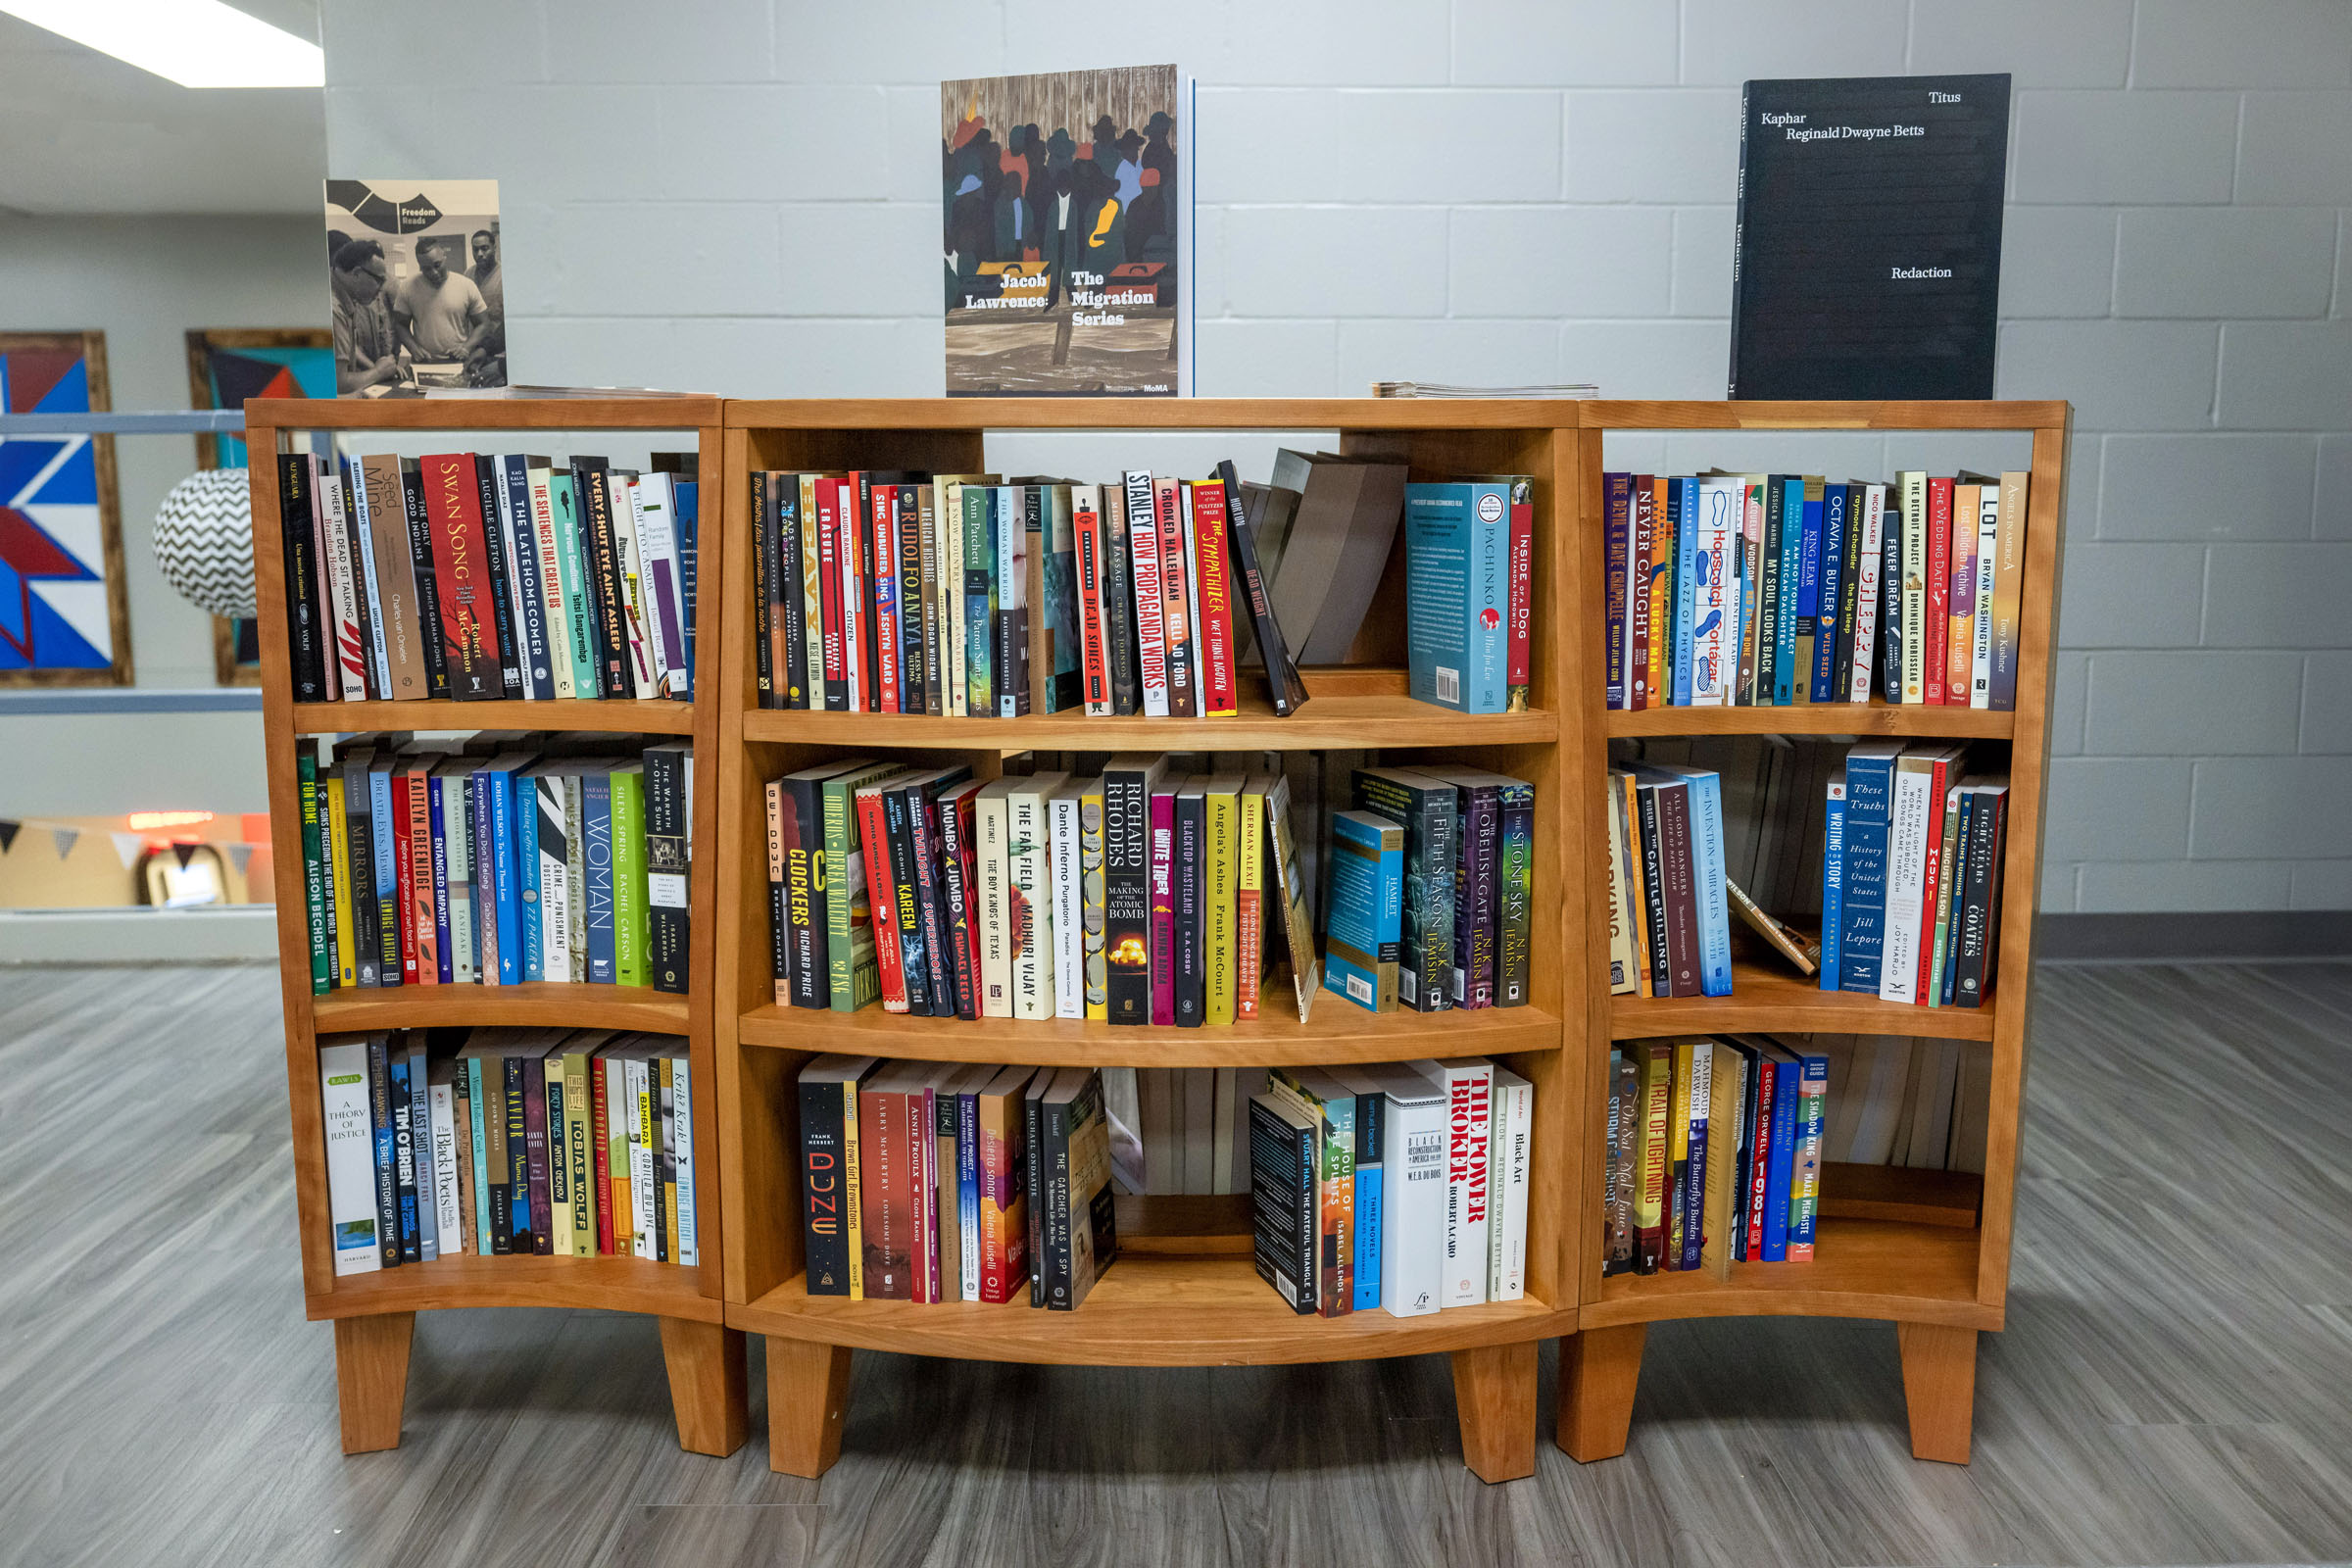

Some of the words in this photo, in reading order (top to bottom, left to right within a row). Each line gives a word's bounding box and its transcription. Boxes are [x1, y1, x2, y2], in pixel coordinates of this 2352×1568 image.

[1929, 92, 1961, 103] Titus
[1762, 113, 1806, 124] Kaphar
[1787, 127, 1838, 141] Reginald
[1842, 126, 1890, 139] Dwayne
[1893, 125, 1924, 137] Betts
[402, 208, 436, 217] Freedom
[1001, 272, 1047, 289] Jacob
[1072, 271, 1103, 286] The
[1891, 268, 1951, 279] Redaction
[965, 295, 1048, 310] Lawrence:
[1072, 291, 1154, 307] Migration
[1072, 312, 1124, 326] Series
[1145, 384, 1168, 393] MoMA
[330, 484, 342, 515] WHERE
[440, 463, 461, 518] SWAN
[482, 479, 496, 523] LUCILLE
[534, 484, 547, 499] THE
[970, 496, 979, 518] Ann
[1128, 474, 1153, 528] STANLEY
[334, 519, 344, 536] THE
[514, 500, 525, 526] THE
[536, 501, 553, 544] SENTENCES
[1161, 488, 1175, 534] CROOKED
[1639, 490, 1650, 551] NEVER
[1829, 496, 1842, 550] OCTAVIA
[1982, 501, 1997, 539] LOT
[337, 538, 347, 563] DEAD
[447, 523, 469, 580] SONG
[487, 526, 501, 571] CLIFTON
[820, 508, 832, 563] ERASURE
[901, 512, 919, 587] RUDOLFO
[971, 522, 981, 564] Patchett
[1133, 532, 1154, 560] HOW
[339, 565, 348, 578] SIT
[543, 546, 554, 564] THAT
[1165, 539, 1179, 601] HALLELUJAH
[1485, 528, 1494, 605] PACHINKO
[1710, 530, 1725, 608] Hopscotch
[1767, 559, 1777, 573] MY
[1828, 556, 1837, 564] E.
[545, 567, 559, 595] CREATE
[1765, 575, 1776, 605] SOUL
[1824, 569, 1836, 611] BUTLER
[1983, 559, 1991, 590] BRYAN
[342, 581, 354, 618] TALKING
[518, 533, 542, 656] LATEHOMECOMER
[549, 597, 561, 609] US
[1136, 564, 1160, 645] PROPAGANDA
[1636, 560, 1648, 638] CAUGHT
[905, 592, 921, 646] ANAYA
[1170, 612, 1182, 640] KELLI
[1682, 611, 1690, 625] OF
[1764, 609, 1773, 643] LOOKS
[1979, 595, 1989, 660] WASHINGTON
[458, 611, 472, 672] McCammon
[471, 623, 482, 659] Robert
[1172, 644, 1184, 658] JO
[1680, 632, 1689, 681] PHYSICS
[1709, 619, 1722, 682] Cortázar
[1762, 646, 1772, 673] BACK
[1144, 647, 1165, 689] WORKS
[1173, 662, 1186, 687] FORD
[302, 781, 315, 800] FUN
[411, 777, 427, 823] KAITLYN
[617, 786, 626, 820] SILENT
[1850, 800, 1886, 809] Truths
[1853, 785, 1883, 795] These
[305, 802, 317, 824] HOME
[824, 795, 843, 839] OMEROS
[942, 805, 957, 852] MUMBO
[1019, 804, 1031, 825] THE
[1059, 805, 1069, 837] Dante
[1108, 782, 1124, 867] RHODES
[1127, 782, 1143, 867] RICHARD
[1215, 804, 1226, 855] Angela's
[1829, 812, 1841, 851] WRITING
[617, 825, 627, 862] SPRING
[1020, 831, 1030, 852] FAR
[1510, 832, 1524, 887] STONE
[352, 824, 368, 899] MIRRORS
[414, 830, 429, 891] GREENIDGE
[587, 814, 612, 928] WOMAN
[826, 850, 846, 884] DEREK
[1020, 858, 1032, 891] FIELD
[1059, 842, 1070, 881] Inferno
[1216, 859, 1225, 895] Ashes
[1829, 860, 1841, 889] STORY
[1929, 848, 1938, 885] MAUS
[309, 859, 320, 902] ALISON
[619, 874, 628, 912] RACHEL
[789, 849, 809, 925] CLOCKERS
[948, 867, 962, 912] JUMBO
[1389, 877, 1397, 916] HAMLET
[829, 889, 848, 938] WALCOTT
[1060, 885, 1070, 926] Purgatorio
[1216, 906, 1225, 941] Frank
[1509, 892, 1522, 922] SKY
[312, 906, 324, 956] BECHDEL
[621, 918, 630, 960] CARSON
[799, 929, 809, 967] RICHARD
[1022, 906, 1034, 958] MADHURI
[1965, 906, 1979, 956] COATES
[802, 971, 812, 998] PRICE
[1023, 963, 1035, 996] VIJAY
[1216, 946, 1225, 996] McCourt
[414, 1090, 425, 1106] THE
[1470, 1073, 1489, 1132] THE
[1649, 1082, 1667, 1118] TRAIL
[1763, 1071, 1772, 1111] GEORGE
[416, 1108, 426, 1131] LAST
[1332, 1122, 1341, 1149] THE
[1343, 1111, 1351, 1135] THE
[1449, 1079, 1469, 1183] BROKER
[1649, 1120, 1666, 1136] OF
[1760, 1115, 1769, 1154] ORWELL
[416, 1132, 428, 1153] SHOT
[573, 1122, 584, 1174] TOBIAS
[1514, 1133, 1524, 1164] Black
[1330, 1156, 1340, 1205] SPIRITS
[1342, 1146, 1351, 1190] HOUSE
[1468, 1136, 1487, 1223] POWER
[1513, 1166, 1523, 1184] Art
[1645, 1138, 1665, 1203] LIGHTNING
[381, 1173, 392, 1207] HISTORY
[576, 1183, 586, 1229] WOLFF
[1343, 1195, 1350, 1212] OF
[1448, 1186, 1457, 1222] ROBERT
[1753, 1162, 1764, 1227] 1984
[385, 1210, 393, 1219] OF
[385, 1222, 394, 1243] TIME
